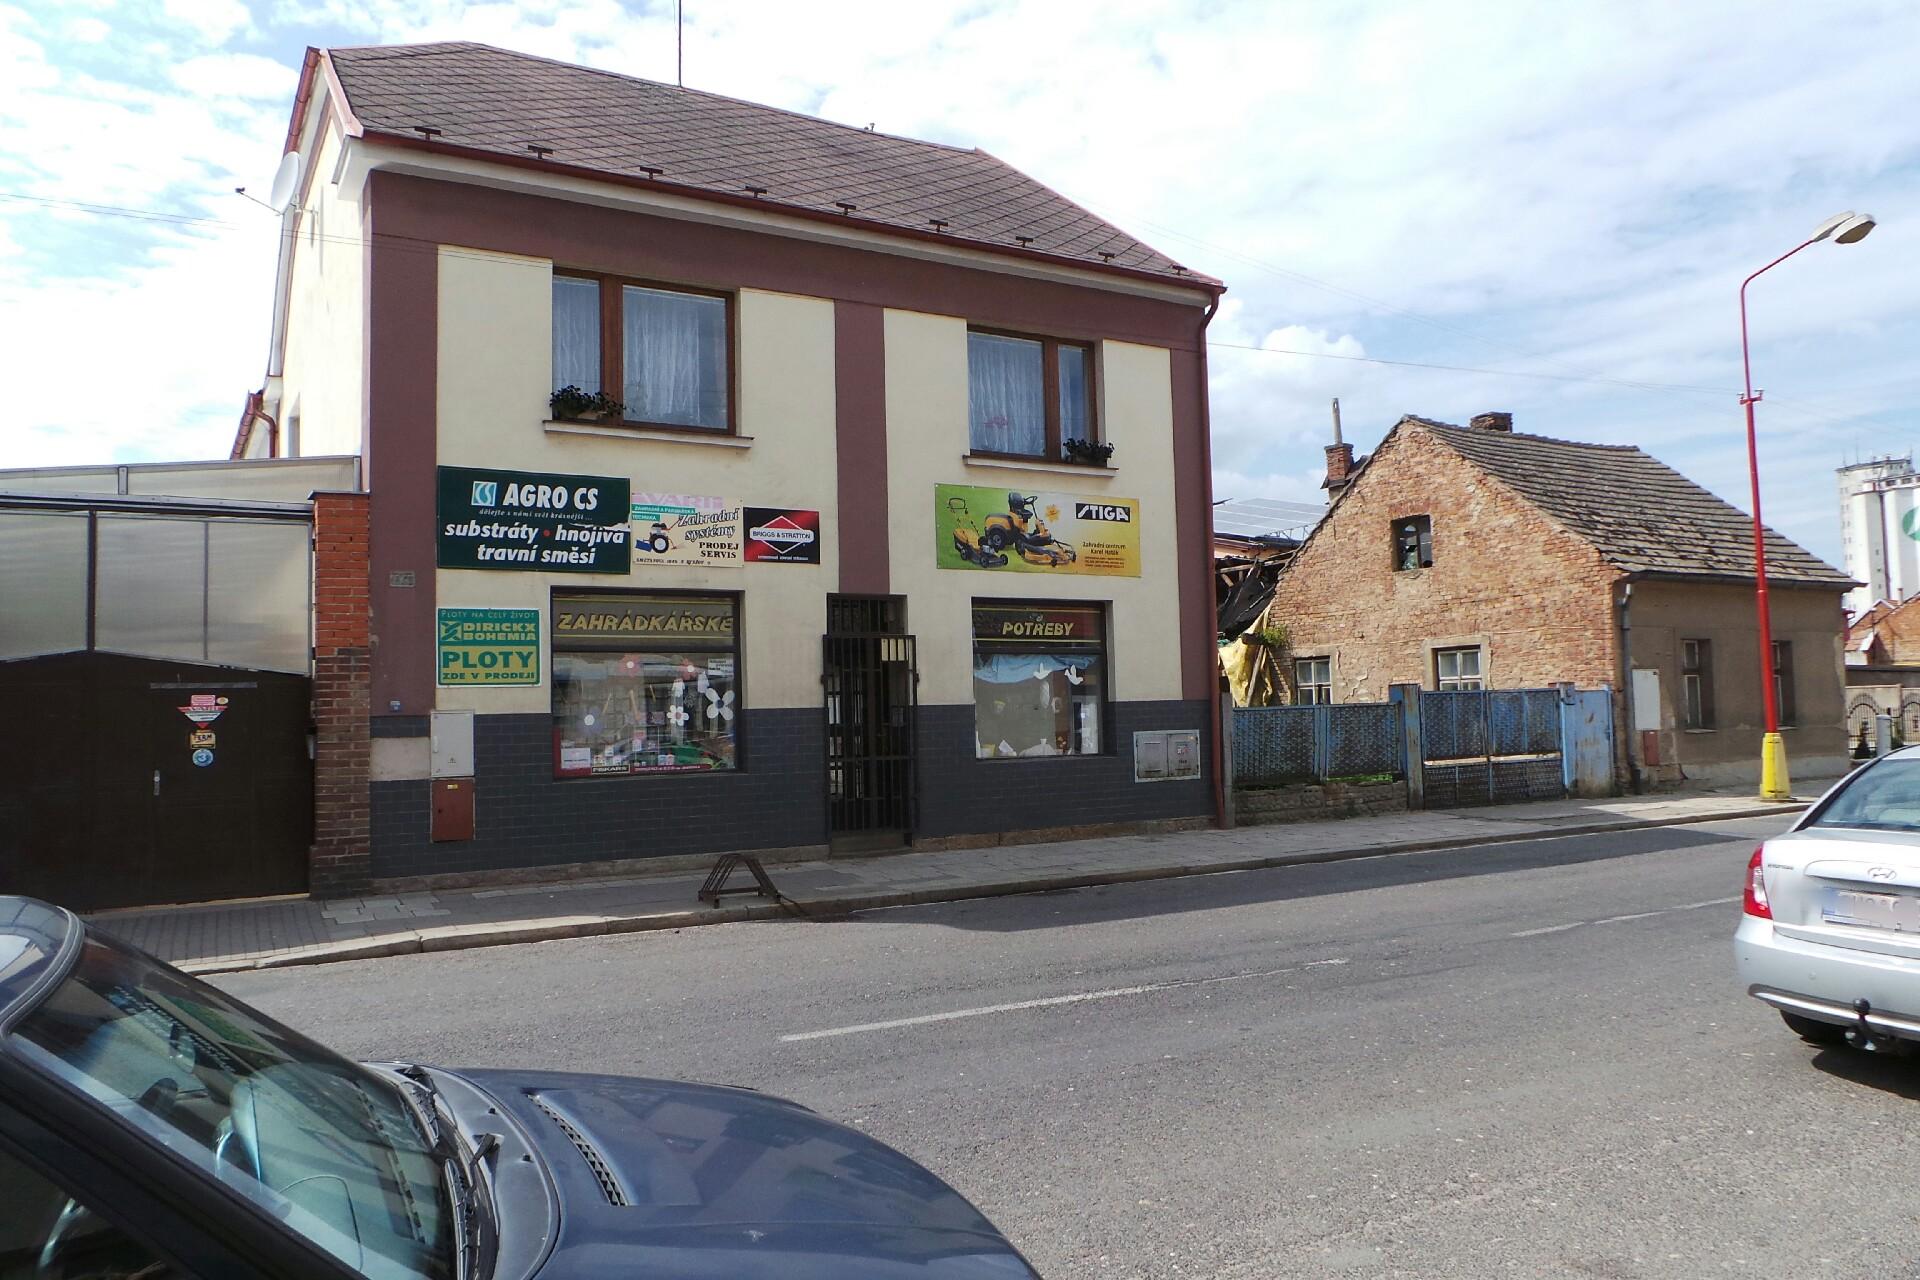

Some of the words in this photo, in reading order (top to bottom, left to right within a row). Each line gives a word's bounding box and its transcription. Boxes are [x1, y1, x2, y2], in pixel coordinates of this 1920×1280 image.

[503, 483, 568, 509] AGRO
[574, 488, 598, 510] CS
[678, 508, 740, 527] Zahradní
[1077, 505, 1128, 520] STIGA
[445, 520, 539, 544] substráty
[555, 525, 624, 547] hnojiva
[685, 525, 736, 542] systémy
[477, 544, 538, 562] travní
[541, 546, 596, 564] směsi
[699, 541, 739, 551] PRODEJ
[700, 550, 737, 559] SERVIS
[441, 610, 467, 618] PLOTY
[557, 609, 733, 632] ZAHRÁDKÁŘSKÉ
[463, 622, 536, 632] DIRICKX
[463, 632, 537, 641] BOHEMIA
[442, 651, 533, 669] PLOTY
[442, 672, 466, 680] ZDE
[471, 672, 479, 680] V
